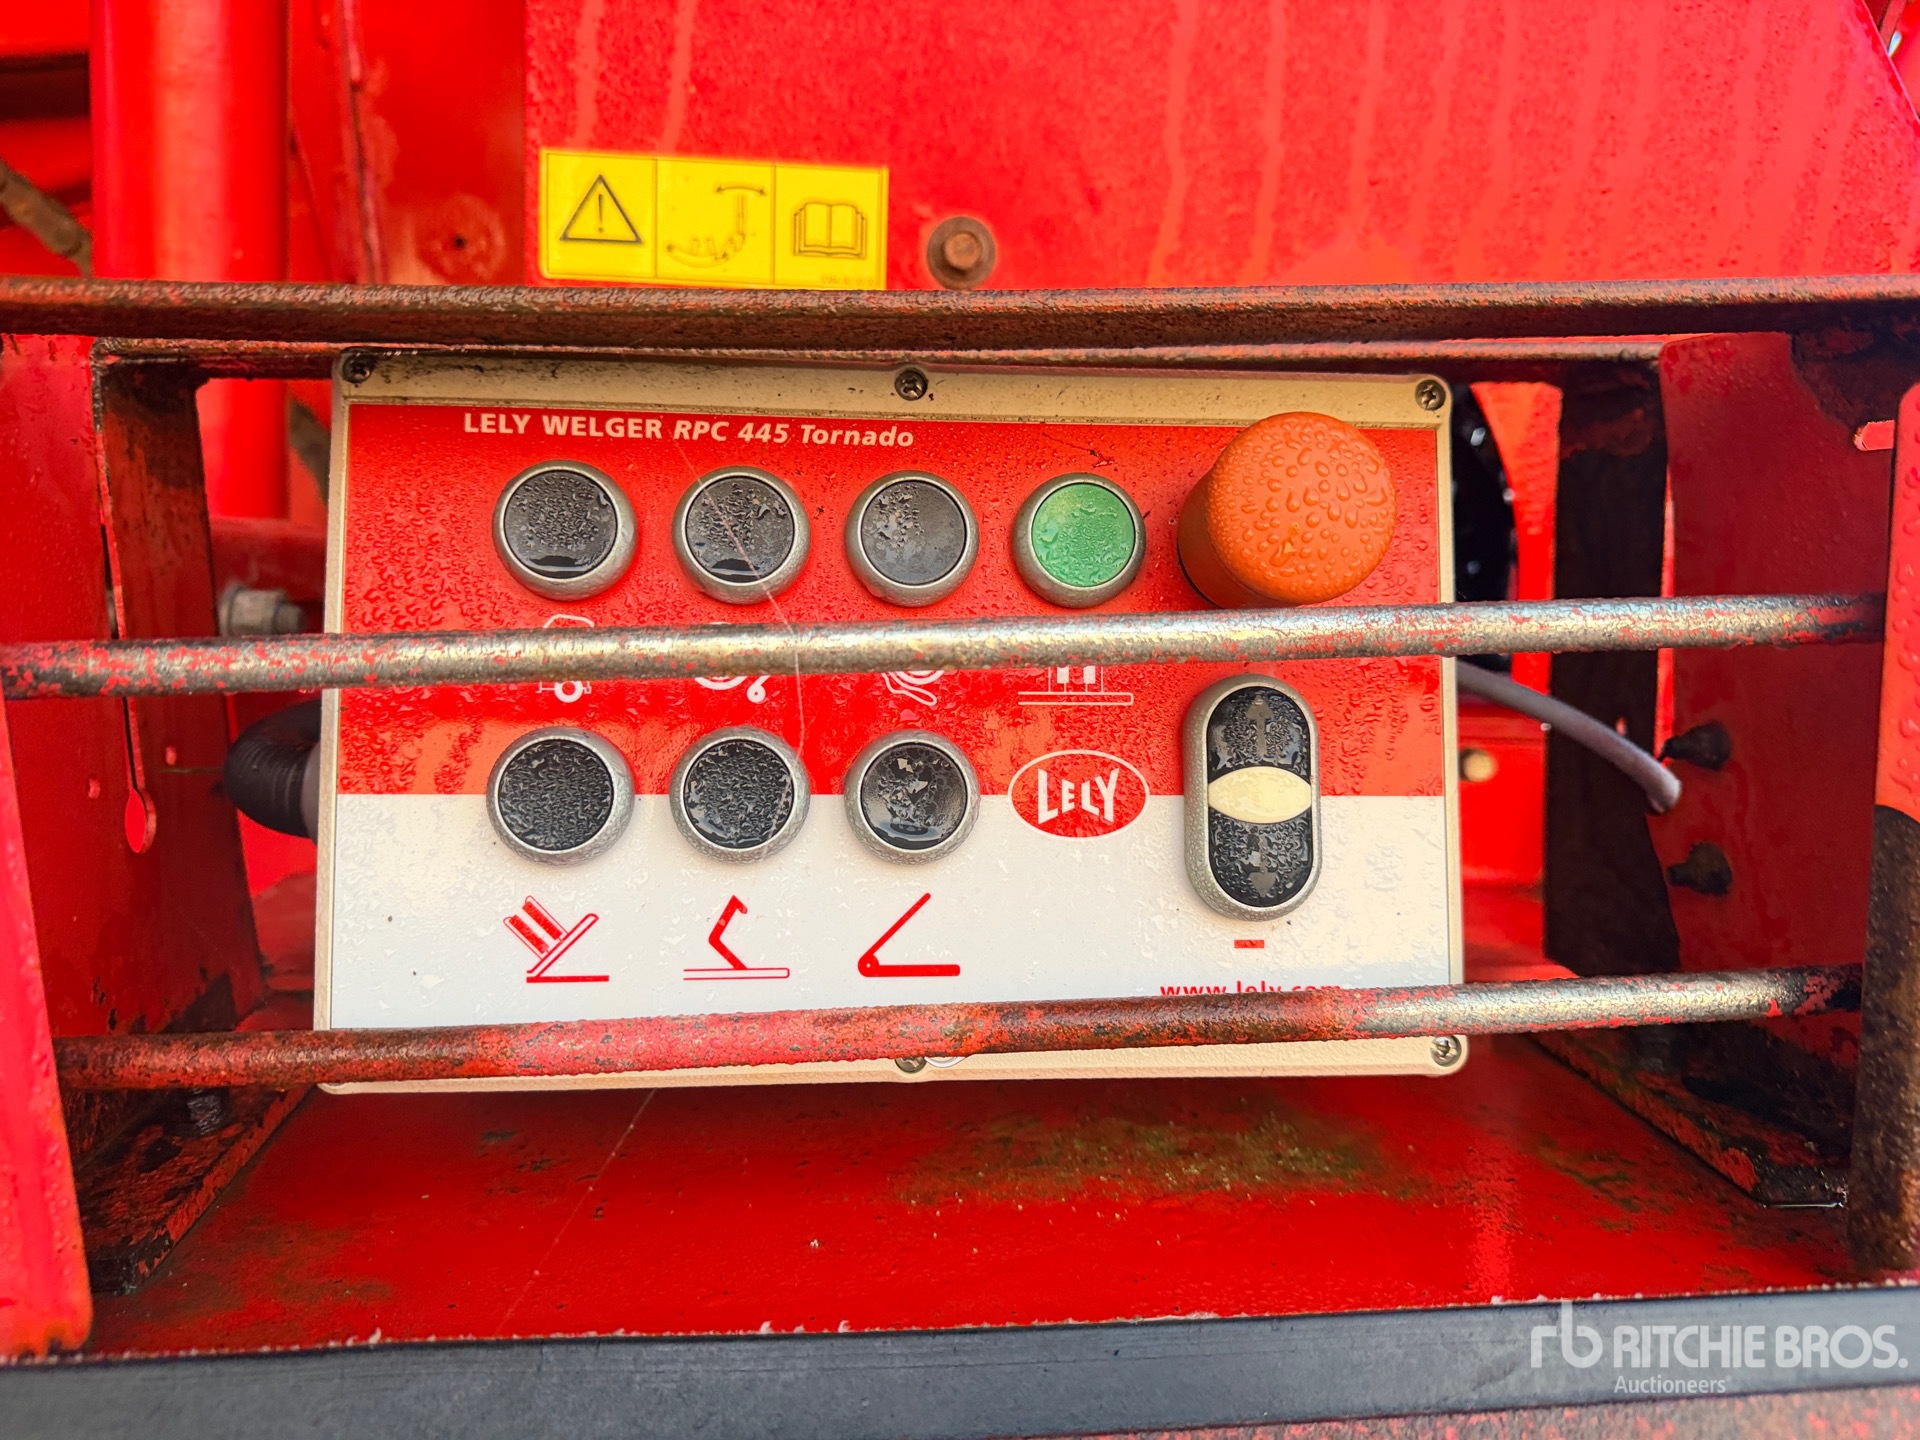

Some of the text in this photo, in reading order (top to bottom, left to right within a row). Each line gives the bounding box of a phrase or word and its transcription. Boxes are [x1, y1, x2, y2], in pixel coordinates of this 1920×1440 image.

[463, 412, 916, 449] LELY WELGER RPC 445 Tornado
[1037, 767, 1120, 825] LELY
